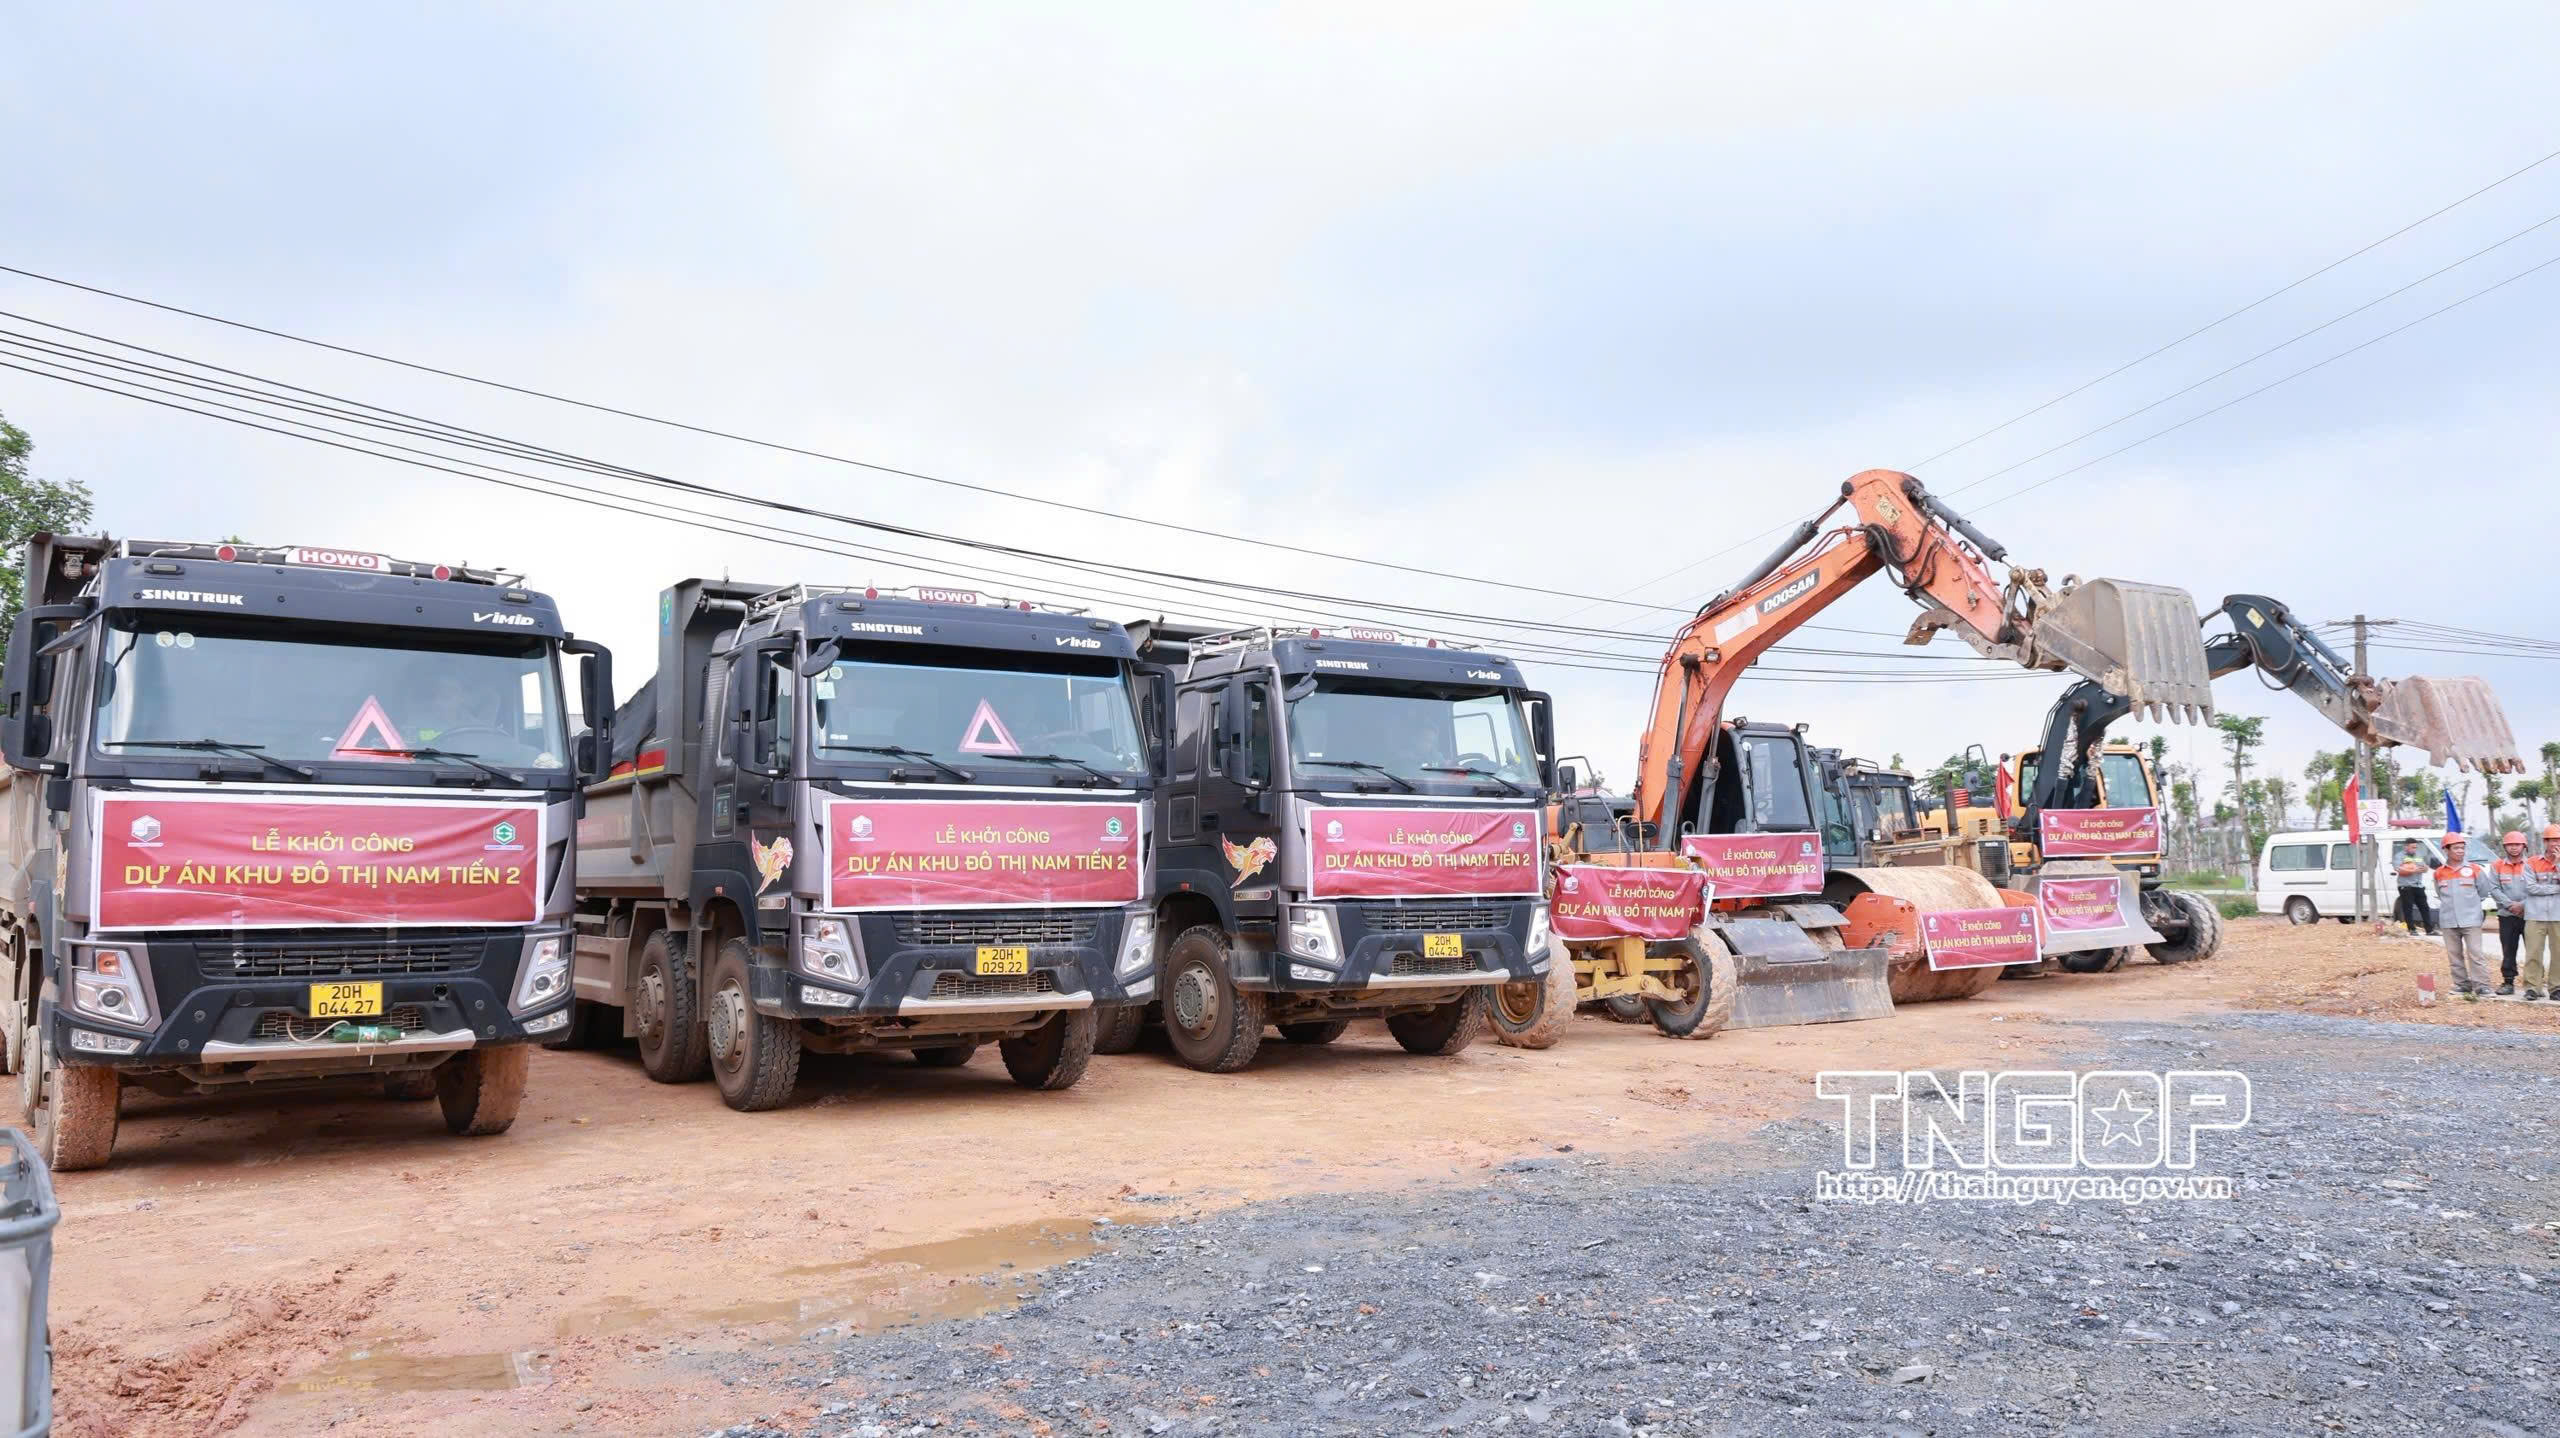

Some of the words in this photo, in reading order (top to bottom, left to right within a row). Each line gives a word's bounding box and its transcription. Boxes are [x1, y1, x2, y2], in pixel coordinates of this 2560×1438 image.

[301, 550, 376, 569] HOWO
[141, 588, 244, 606] SINOTRUK
[920, 589, 975, 603] HOWO
[1763, 573, 1816, 613] DOOSAN
[851, 622, 924, 636] SINOTRUK
[1351, 629, 1394, 642] HOWO
[1315, 658, 1369, 671] SINOTRUK
[251, 827, 282, 852] LỄ
[287, 830, 345, 852] KHỞI
[351, 832, 415, 852] CÔNG
[935, 824, 957, 844] LỄ
[960, 826, 1001, 844] KHỞI
[1005, 827, 1050, 844] CÔNG
[1388, 827, 1404, 845] LỄ
[1407, 830, 1438, 845] KHỞI
[1440, 831, 1474, 845] CÔNG
[848, 855, 881, 877] DỰ
[885, 851, 913, 872] ÁN
[919, 855, 960, 872] KHU
[964, 850, 993, 872] ĐÔ
[998, 855, 1027, 875] THỊ
[1032, 855, 1070, 871] NAM
[1075, 848, 1113, 871] TIẾN
[1117, 855, 1127, 870] 2
[1325, 853, 1350, 872] DỰ
[1353, 851, 1373, 868] ÁN
[1377, 853, 1408, 868] KHU
[1411, 850, 1433, 867] ĐÔ
[1436, 853, 1457, 870] THỊ
[1460, 853, 1489, 867] NAM
[1491, 847, 1520, 867] TIẾN
[1522, 854, 1531, 867] 2
[1722, 848, 1733, 861] LỄ
[1733, 850, 1753, 861] KHỞI
[1754, 850, 1777, 861] CÔNG
[124, 865, 172, 889] DỰ
[176, 859, 217, 885] ÁN
[224, 865, 283, 885] KHU
[290, 860, 331, 885] ĐÔ
[337, 865, 378, 889] THỊ
[386, 865, 440, 885] NAM
[447, 858, 500, 885] TIẾN
[505, 867, 521, 885] 2
[1716, 867, 1734, 877] KHU
[1736, 864, 1750, 877] ĐÔ
[1751, 866, 1767, 878] THỊ
[1767, 865, 1787, 876] NAM
[1788, 862, 1809, 874] TIẾN
[1810, 865, 1817, 874] 2
[1608, 884, 1621, 899] LỄ
[1623, 886, 1647, 899] KHỞI
[1648, 887, 1675, 900] CÔNG
[1558, 903, 1581, 918] DỰ
[1582, 901, 1600, 916] ÁN
[1603, 906, 1621, 917] KHU
[1623, 903, 1640, 918] ĐÔ
[1642, 906, 1658, 920] THỊ
[1658, 907, 1685, 918] NAM
[1434, 936, 1451, 946] 20H
[991, 949, 1014, 960] 20H
[982, 962, 1022, 973] 029.22
[331, 985, 362, 1000] 20H
[318, 1000, 375, 1016] 044.27
